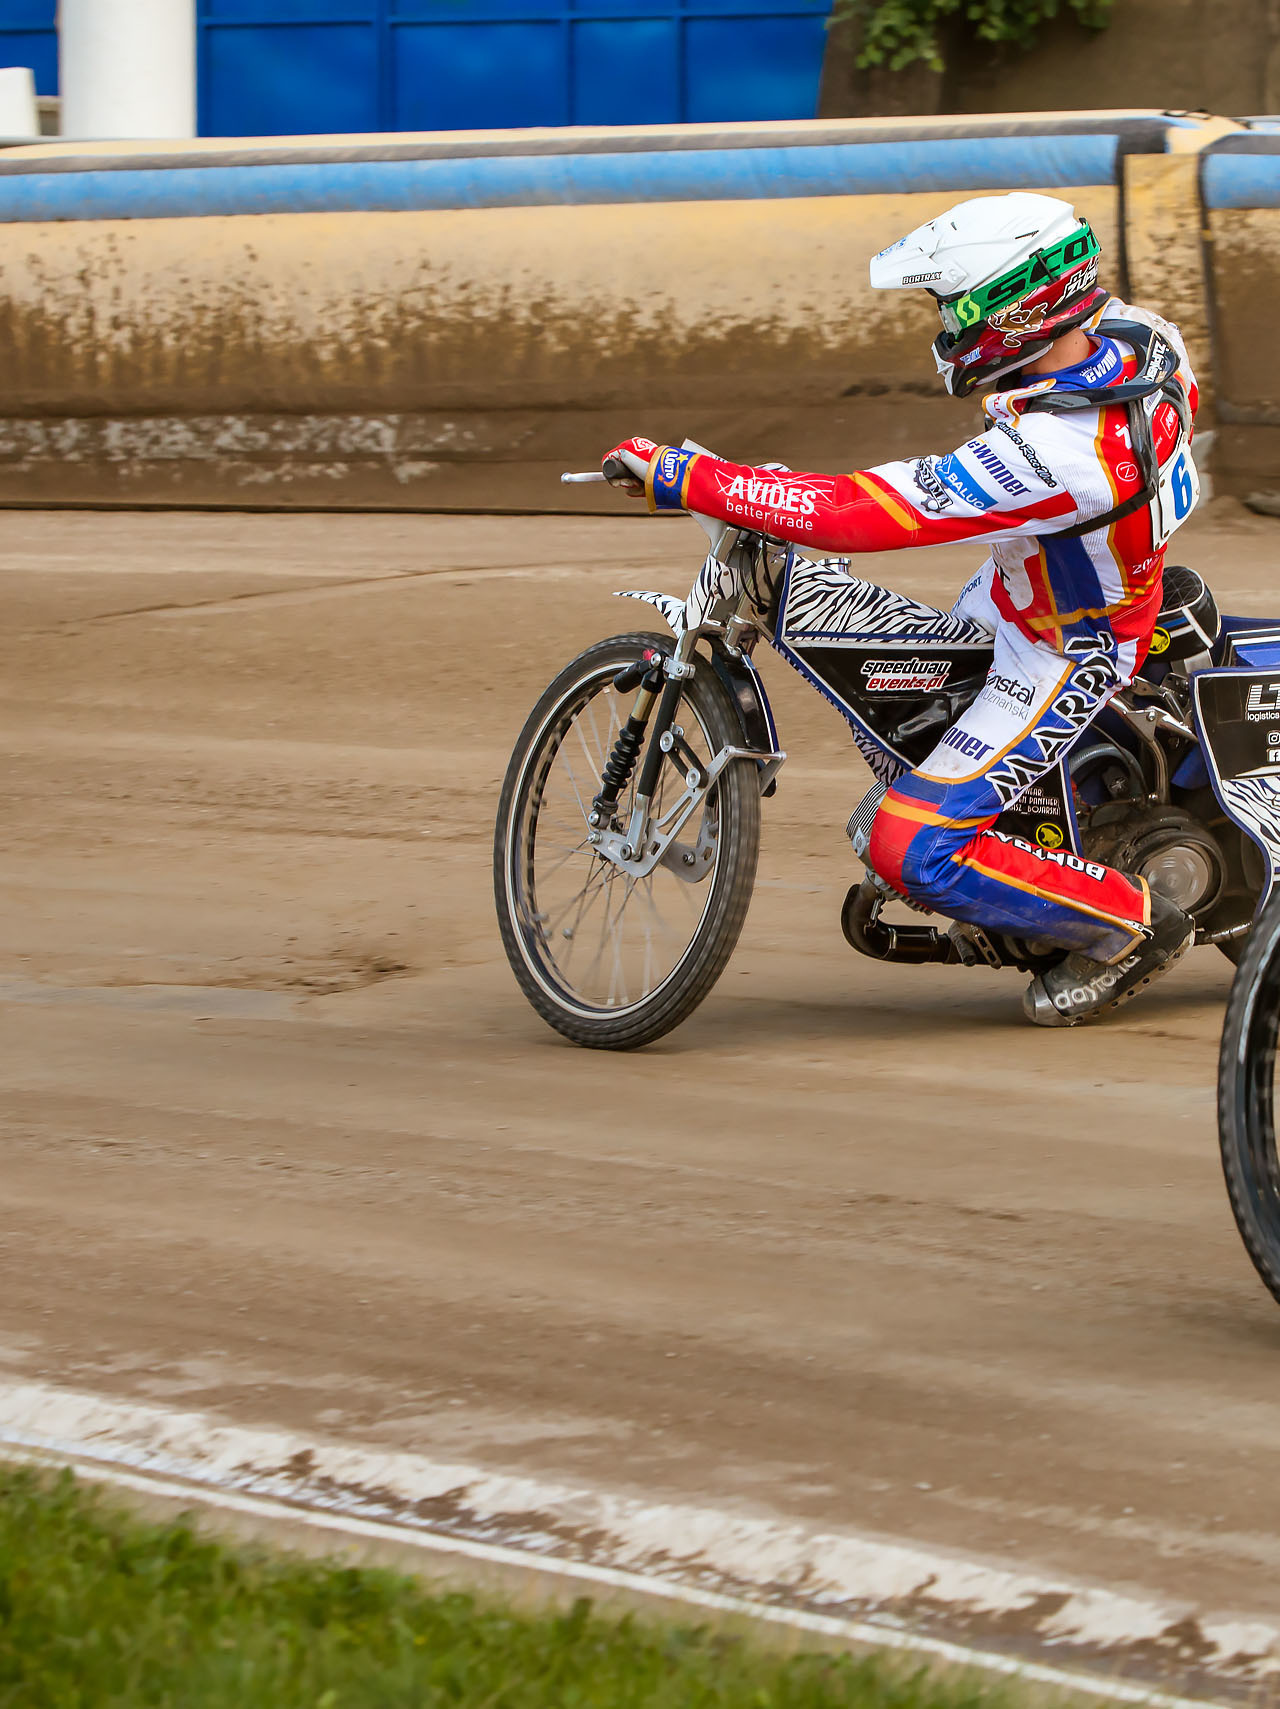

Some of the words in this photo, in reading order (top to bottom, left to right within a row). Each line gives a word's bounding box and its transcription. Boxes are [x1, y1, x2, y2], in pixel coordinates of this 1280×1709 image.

[727, 474, 816, 515] AVIDES
[726, 498, 771, 521] better
[774, 512, 814, 531] trade
[861, 658, 951, 677] speedway
[867, 674, 947, 692] events.pl
[1247, 711, 1280, 722] logistics
